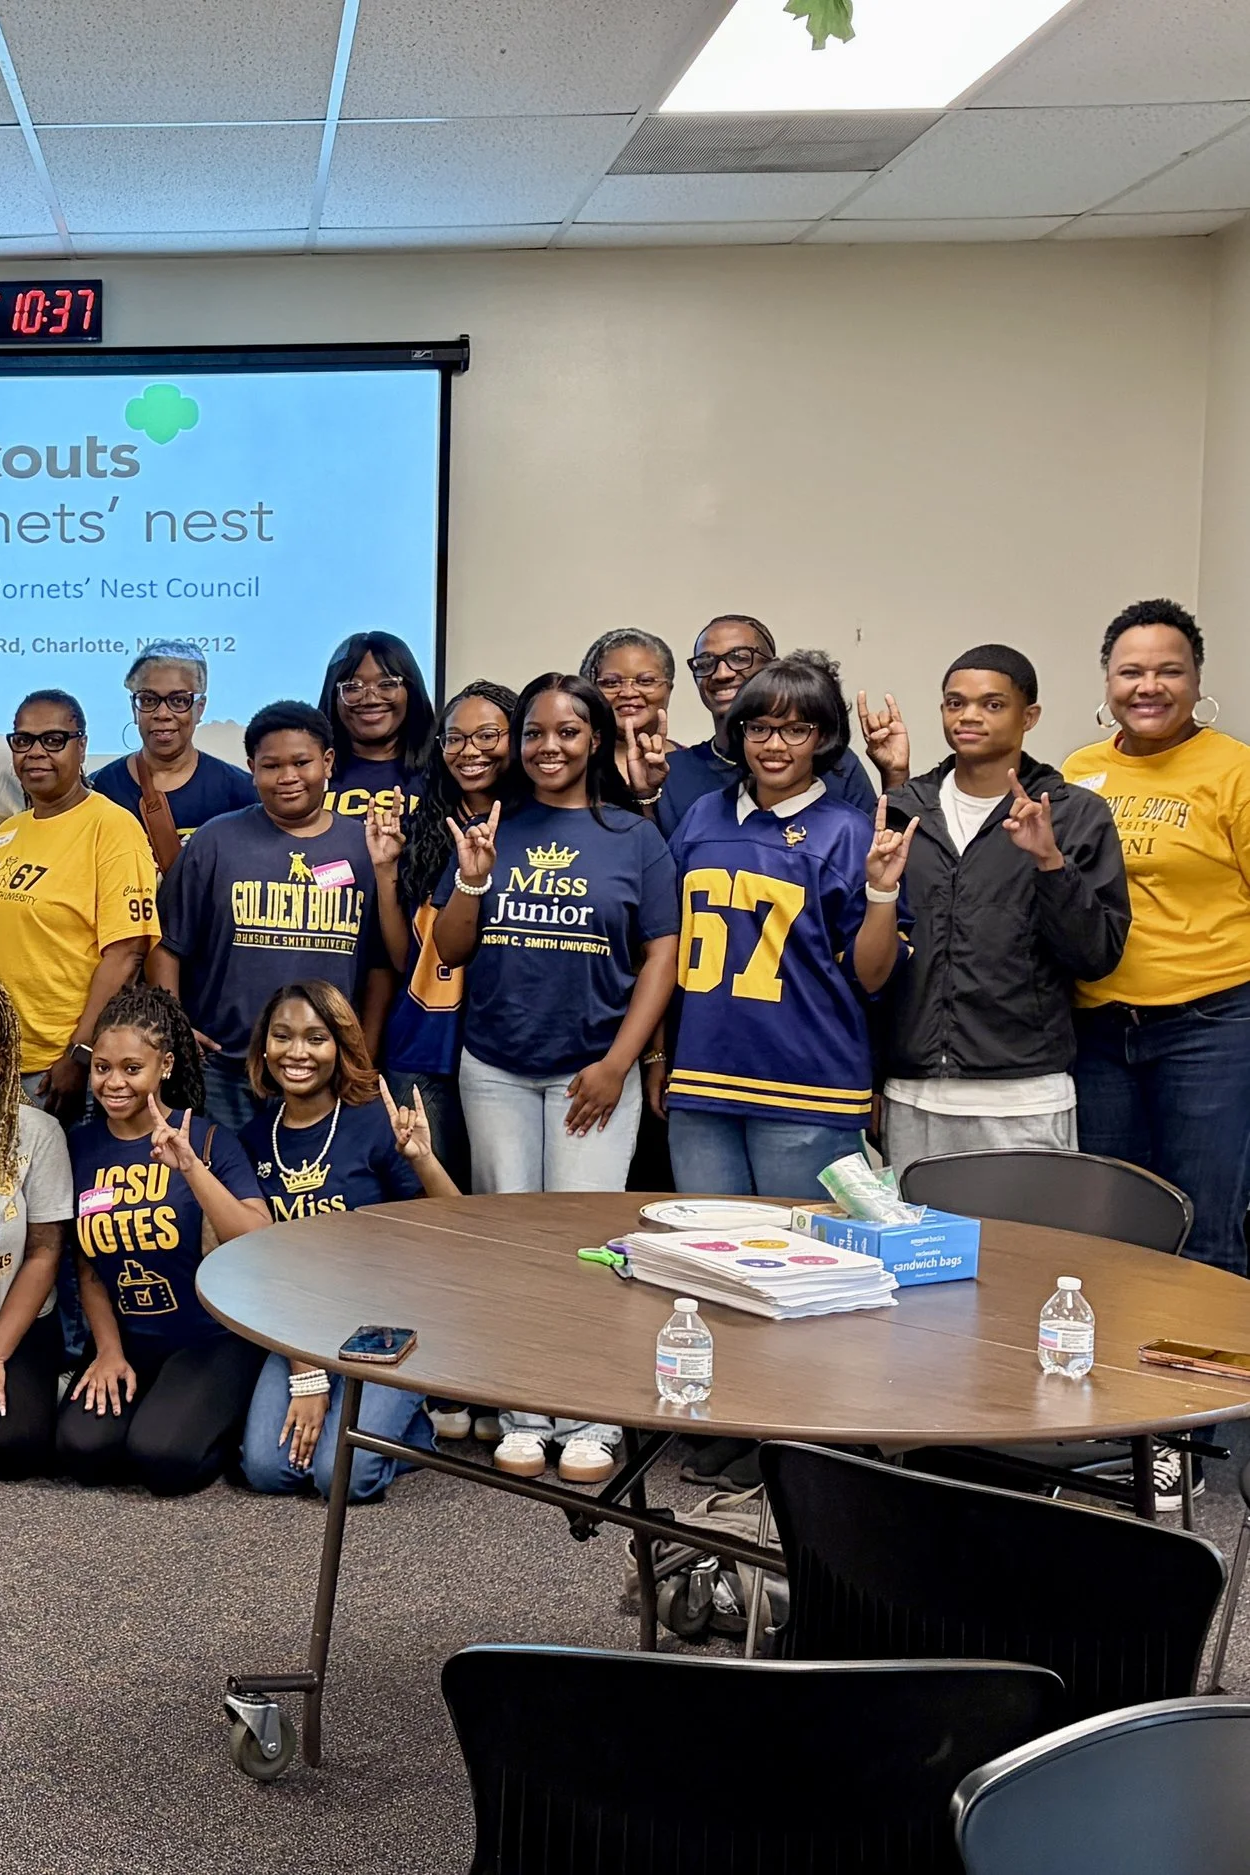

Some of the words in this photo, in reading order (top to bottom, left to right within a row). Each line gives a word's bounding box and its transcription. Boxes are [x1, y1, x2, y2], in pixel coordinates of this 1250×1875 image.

[11, 289, 95, 333] 10:37
[146, 501, 274, 543] nest
[101, 577, 157, 599] Nest
[165, 576, 260, 599] Council
[31, 637, 130, 655] Charlotte,
[1117, 821, 1159, 832] RSITY
[1138, 797, 1192, 832] SMITH
[9, 863, 49, 891] 67
[505, 867, 588, 897] Miss
[128, 898, 153, 922] 96
[231, 880, 306, 930] GOLDEN
[307, 884, 365, 935] BULLS
[490, 893, 594, 926] Junior
[233, 933, 271, 946] JOHNSON
[282, 936, 311, 948] SMITH
[482, 934, 509, 945] NSON
[511, 936, 522, 947] C.
[524, 937, 558, 950] SMITH
[677, 867, 806, 1004] 67
[270, 1193, 347, 1221] Miss
[76, 1205, 180, 1258] VOTES
[893, 1258, 938, 1272] sandwich
[939, 1255, 963, 1270] bags
